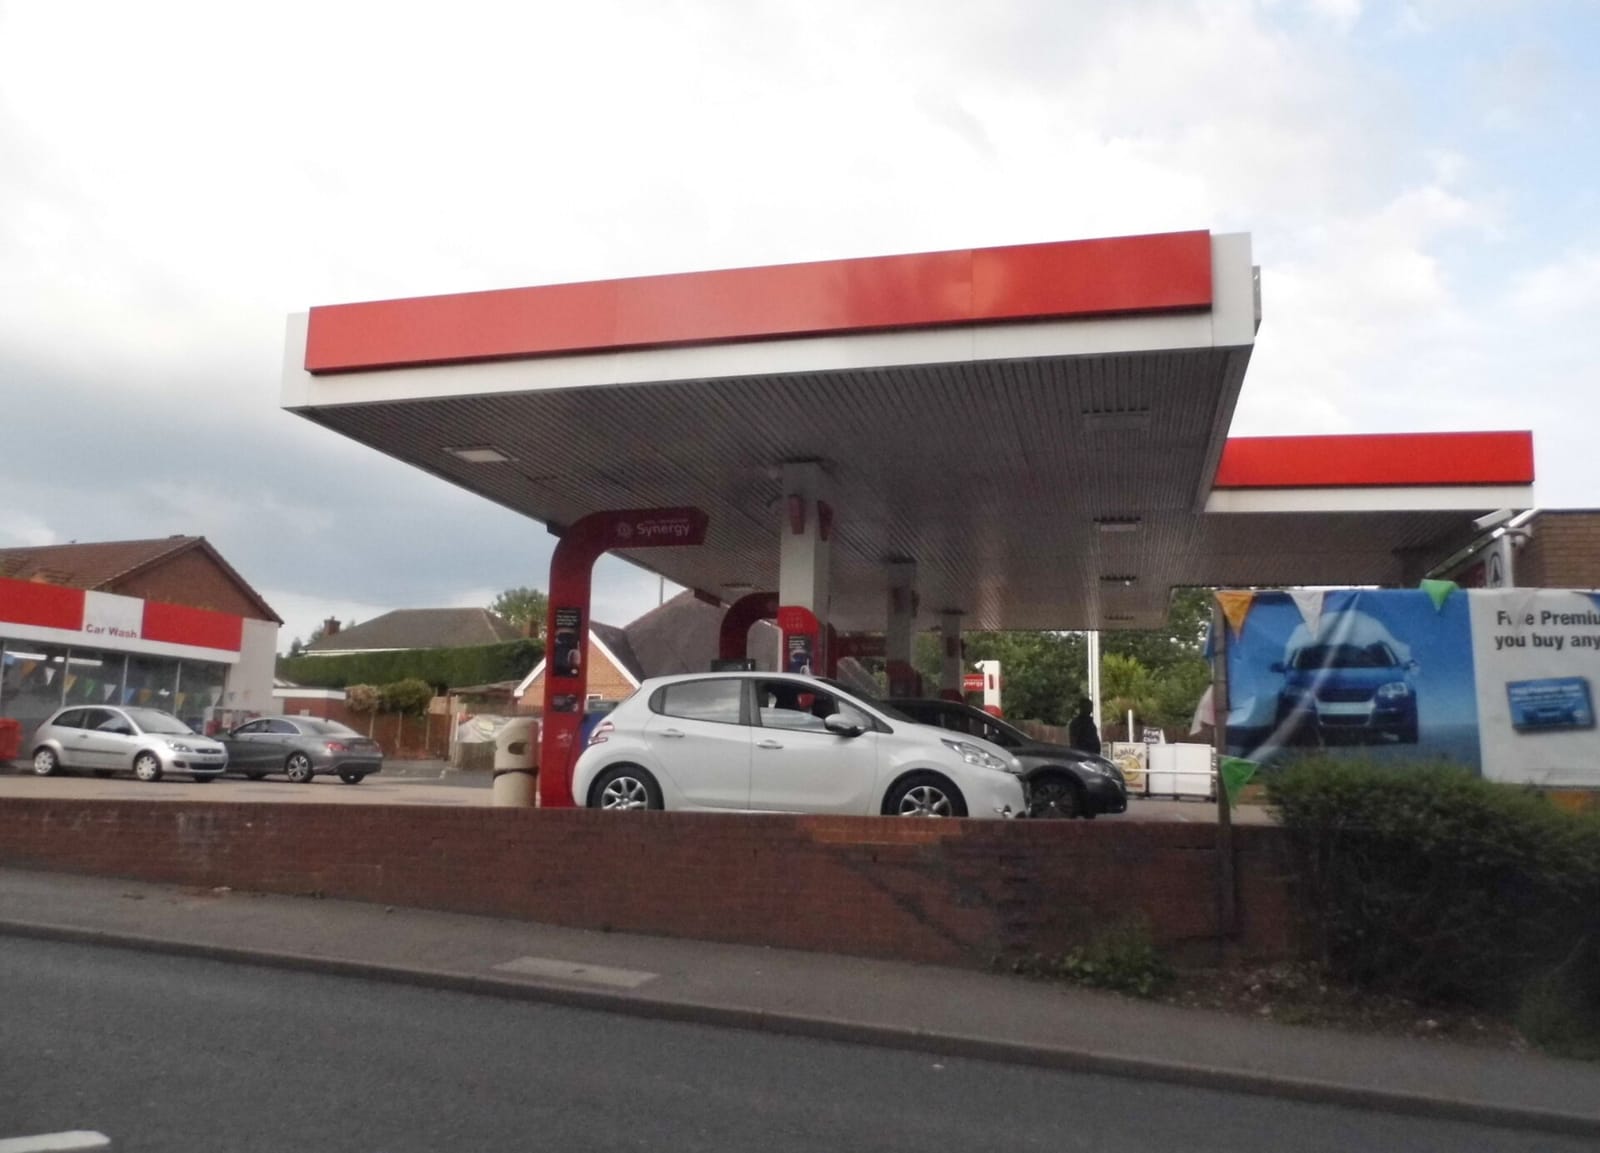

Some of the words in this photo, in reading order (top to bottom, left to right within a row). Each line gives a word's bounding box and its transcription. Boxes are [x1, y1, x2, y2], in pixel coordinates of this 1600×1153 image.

[636, 522, 690, 537] Synergy
[1497, 610, 1535, 626] Fe
[86, 623, 106, 634] Car
[108, 626, 138, 639] Wash
[1494, 635, 1526, 651] you
[1532, 632, 1564, 651] buy
[1571, 635, 1600, 650] any
